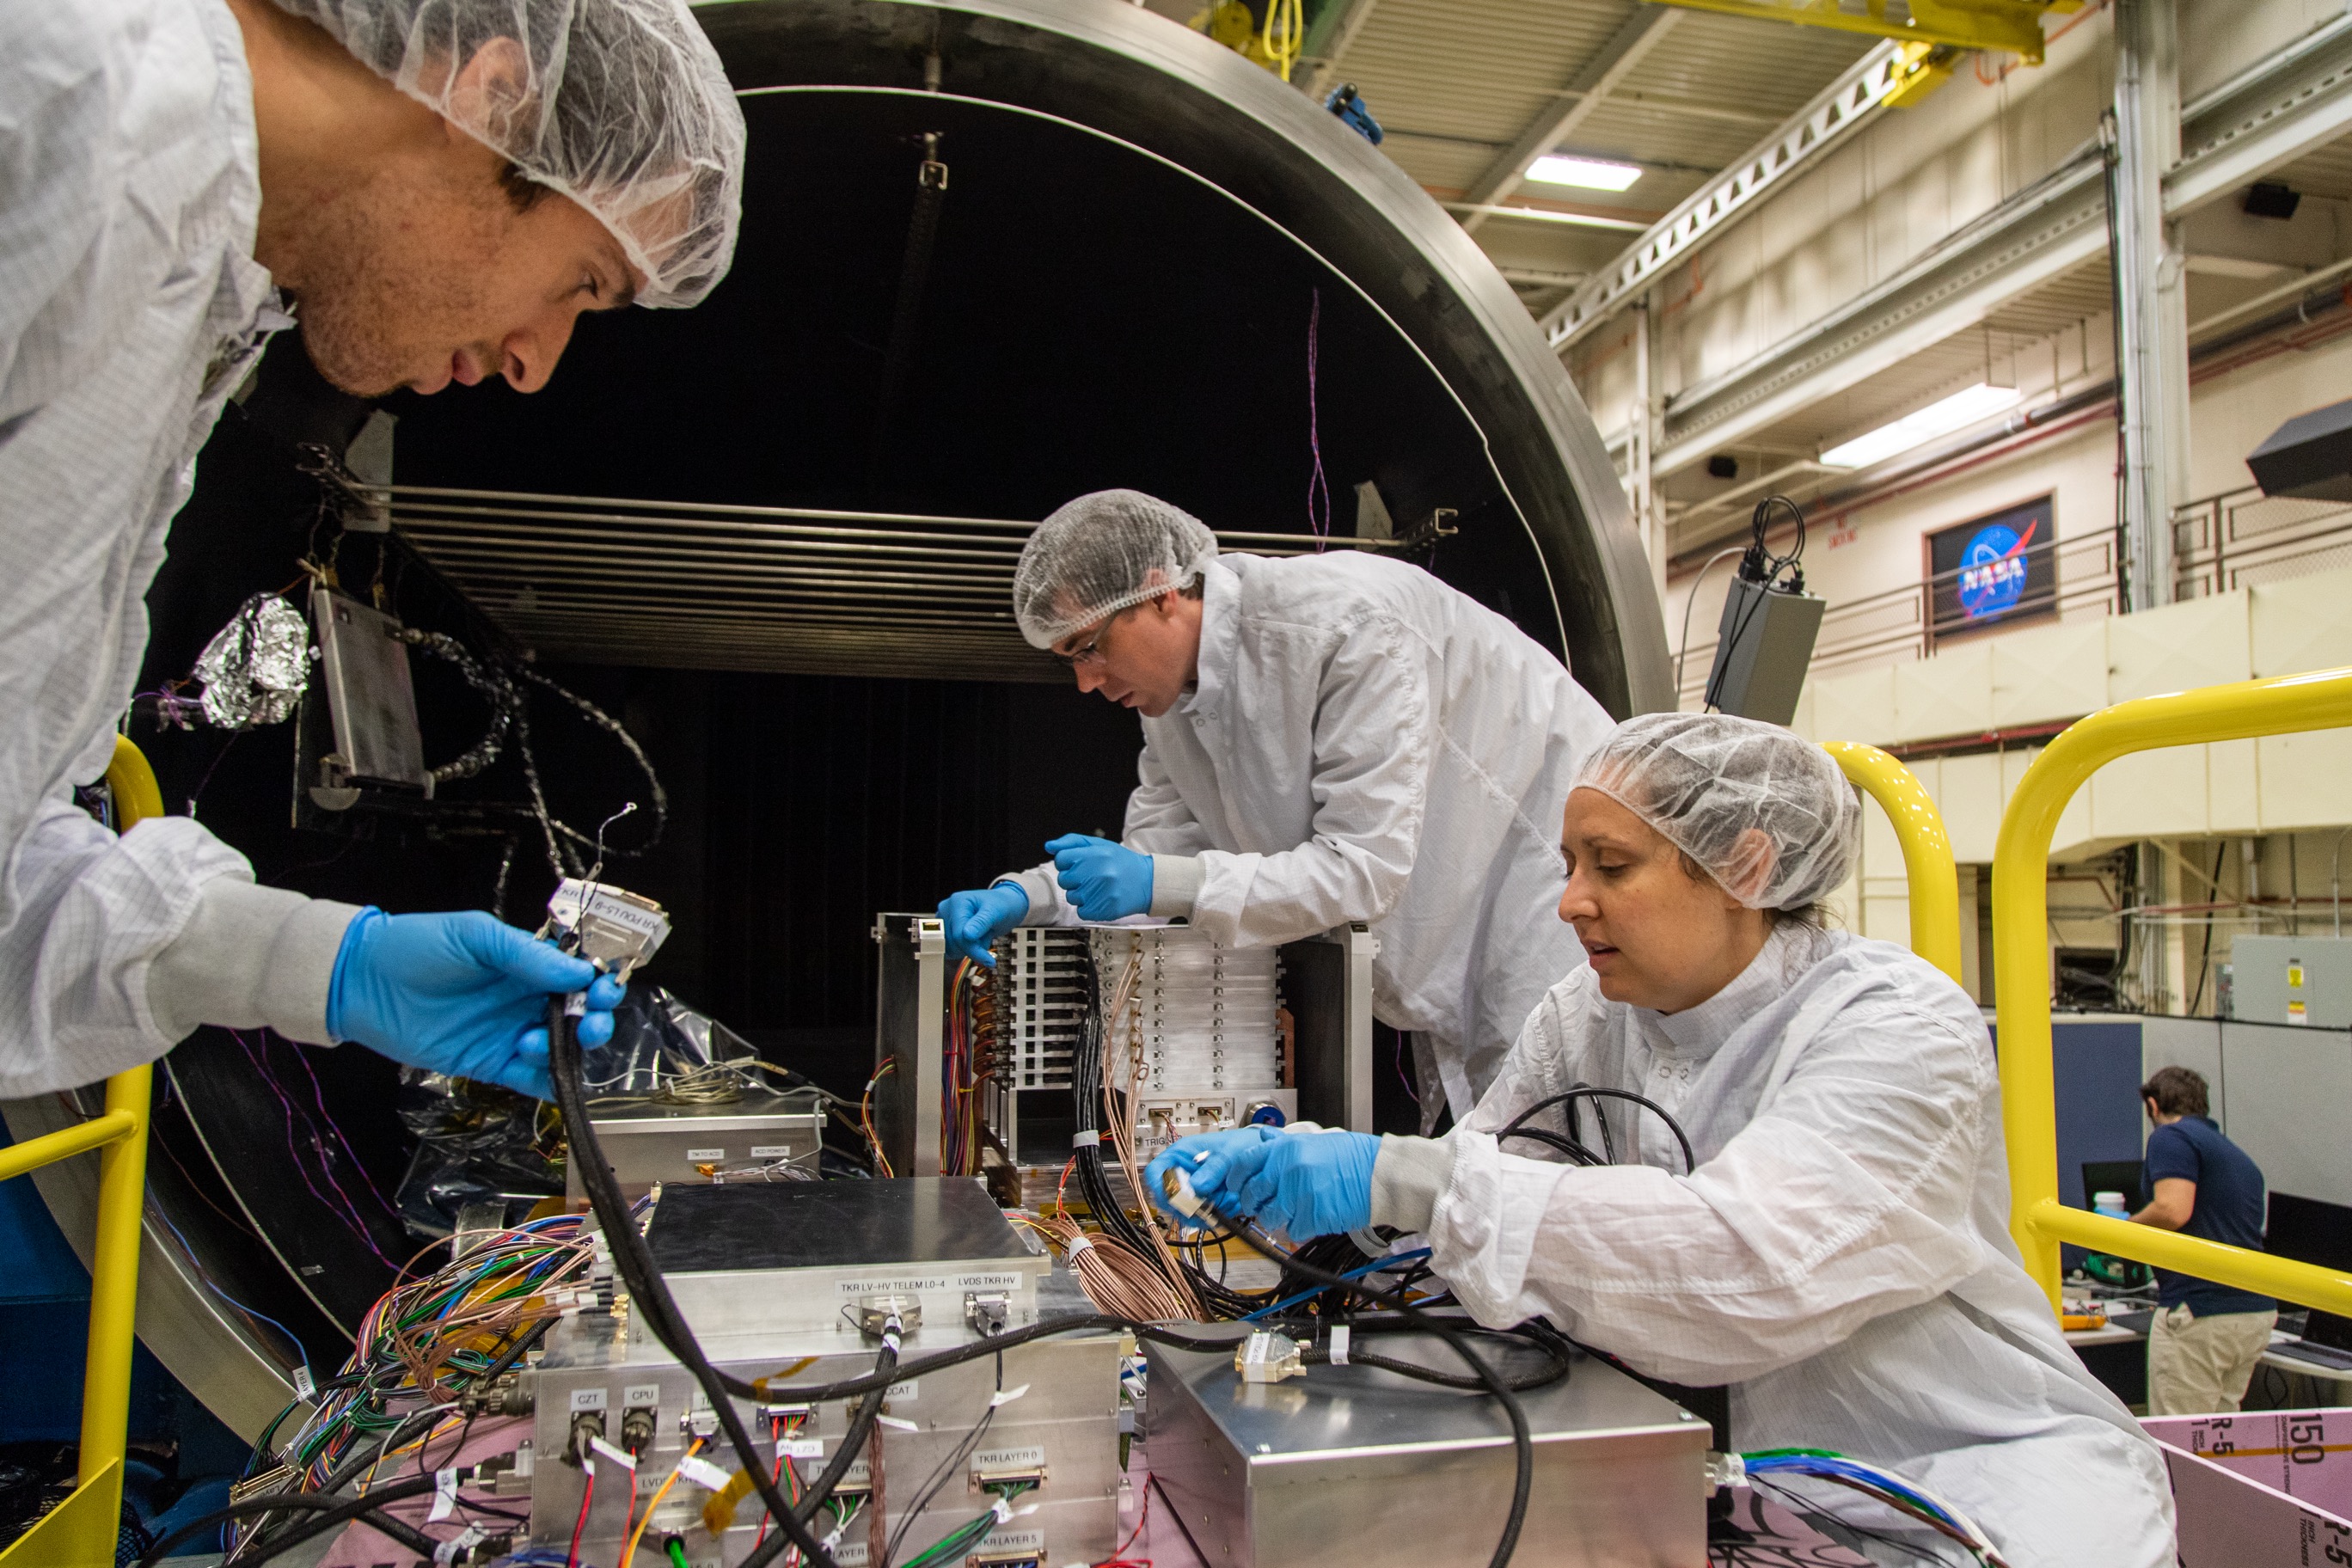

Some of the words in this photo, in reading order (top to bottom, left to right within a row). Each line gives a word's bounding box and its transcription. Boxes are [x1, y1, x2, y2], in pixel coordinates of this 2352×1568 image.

[1963, 557, 2024, 591] NASA
[842, 1283, 860, 1291] TKR
[861, 1282, 891, 1291] LV-HV
[892, 1281, 923, 1289] TELEM
[959, 1276, 982, 1285] LVDS
[983, 1275, 1001, 1284] TKR
[1002, 1276, 1015, 1284] HV
[578, 1393, 597, 1404] CZT
[632, 1390, 653, 1401] CPU
[2211, 1418, 2234, 1455] R-5
[2289, 1413, 2324, 1464] 150
[978, 1454, 997, 1464] TKR
[999, 1451, 1030, 1462] LAYER
[998, 1534, 1030, 1546] LAYER
[1031, 1534, 1037, 1544] 5
[2299, 1517, 2309, 1567] THICKNESS
